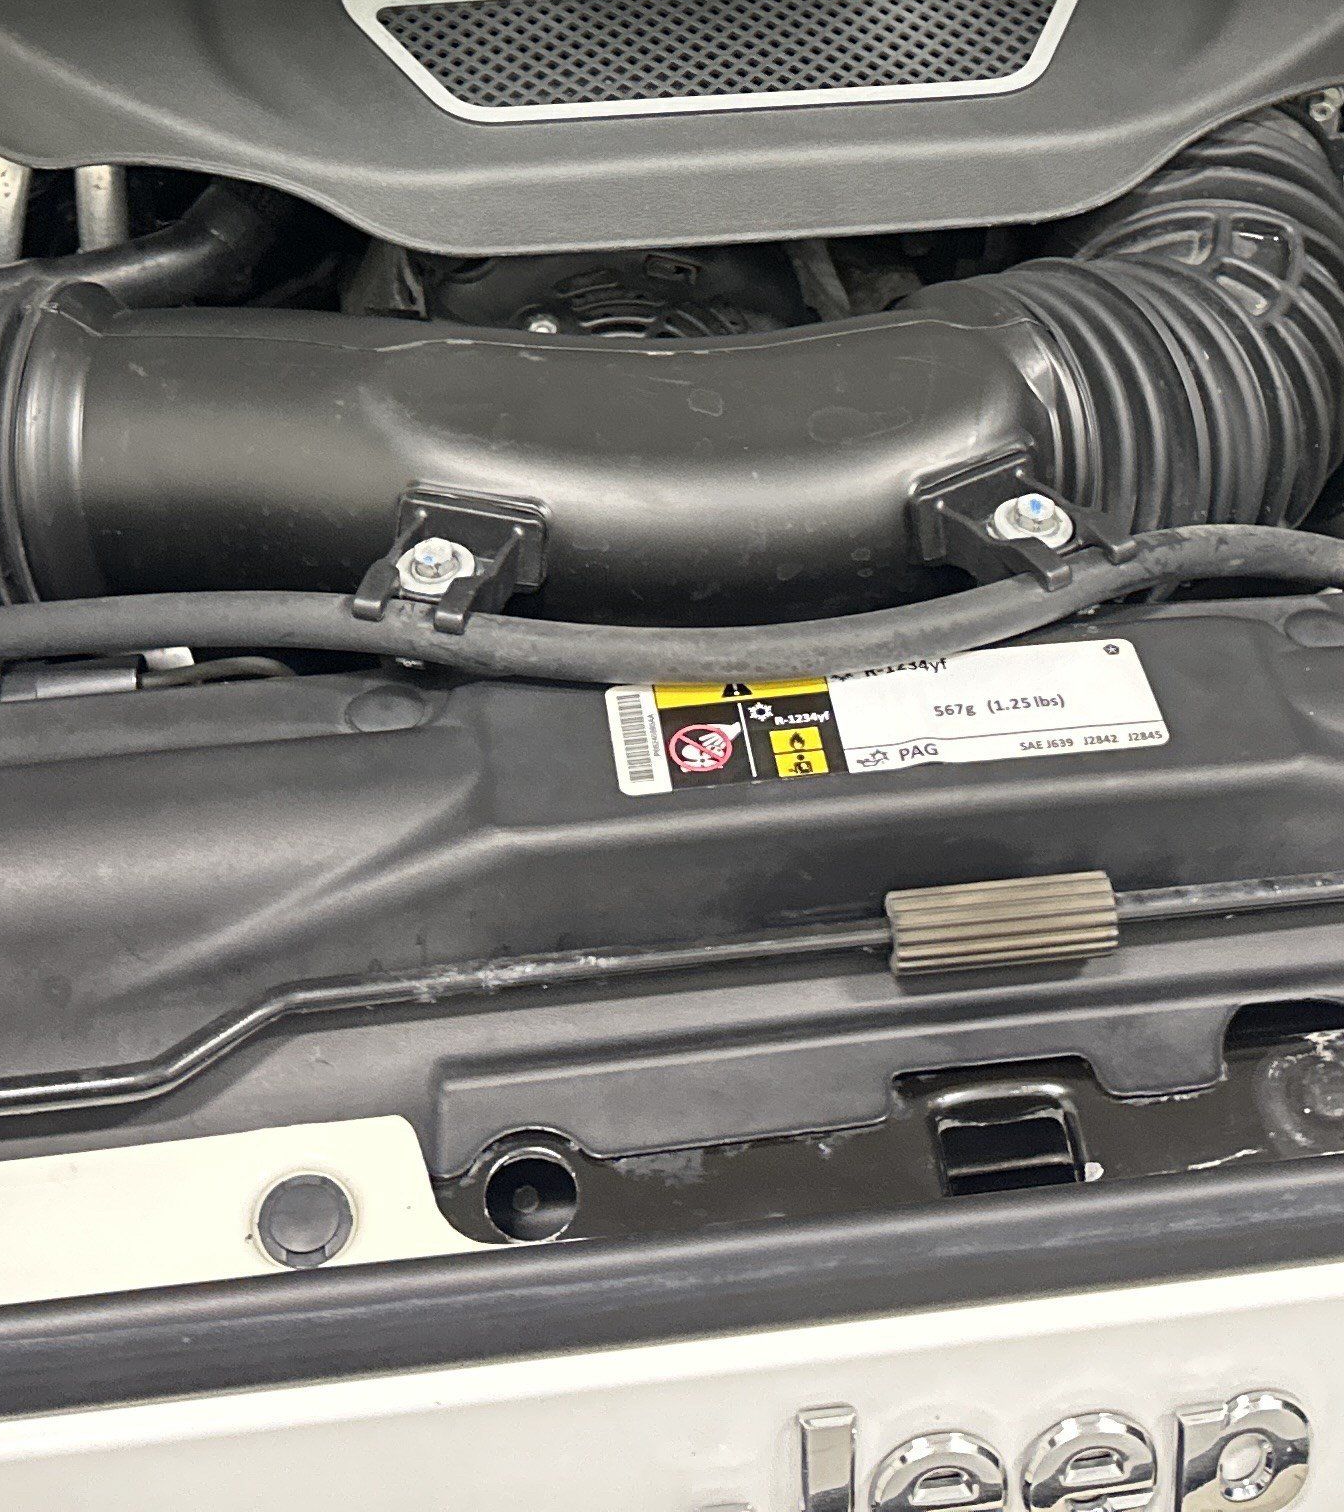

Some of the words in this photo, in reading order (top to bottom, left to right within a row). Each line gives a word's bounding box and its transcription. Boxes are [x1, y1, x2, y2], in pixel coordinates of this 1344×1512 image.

[934, 702, 976, 718] 567g
[987, 698, 1031, 715] (1.25
[1034, 693, 1065, 710] lbs)
[774, 711, 831, 726] R-1234yf
[1019, 741, 1044, 750] SAE
[1046, 738, 1074, 749] J639
[1083, 734, 1119, 746] J2842
[1128, 730, 1163, 742] J2845
[898, 744, 939, 761] PAG
